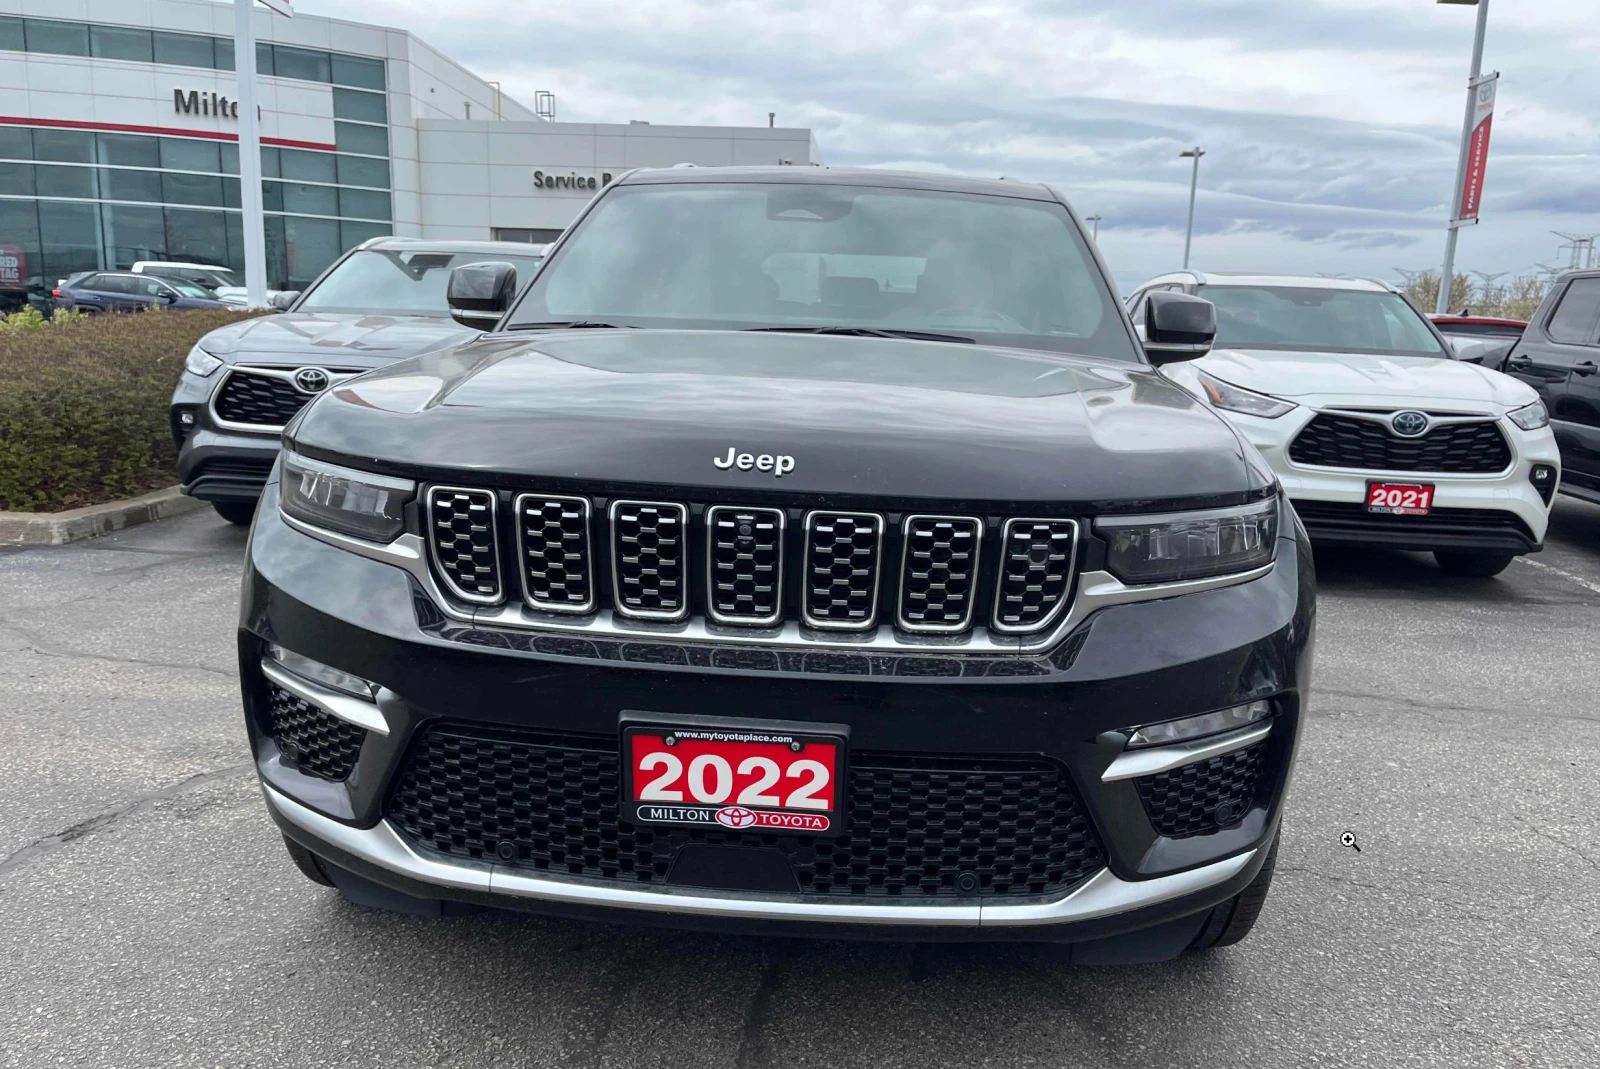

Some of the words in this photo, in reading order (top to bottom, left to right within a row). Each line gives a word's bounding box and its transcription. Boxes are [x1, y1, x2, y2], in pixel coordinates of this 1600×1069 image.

[173, 88, 261, 121] Milt
[533, 170, 596, 189] Service
[1467, 178, 1477, 210] PARTS
[1474, 126, 1485, 167] SERVICE
[713, 447, 795, 477] Jeep
[1371, 489, 1429, 508] 2021
[674, 731, 793, 744] www.mytoyotaplace.com
[639, 752, 830, 810] 2022
[650, 808, 709, 821] MILTON
[760, 814, 822, 828] TOYOTA
